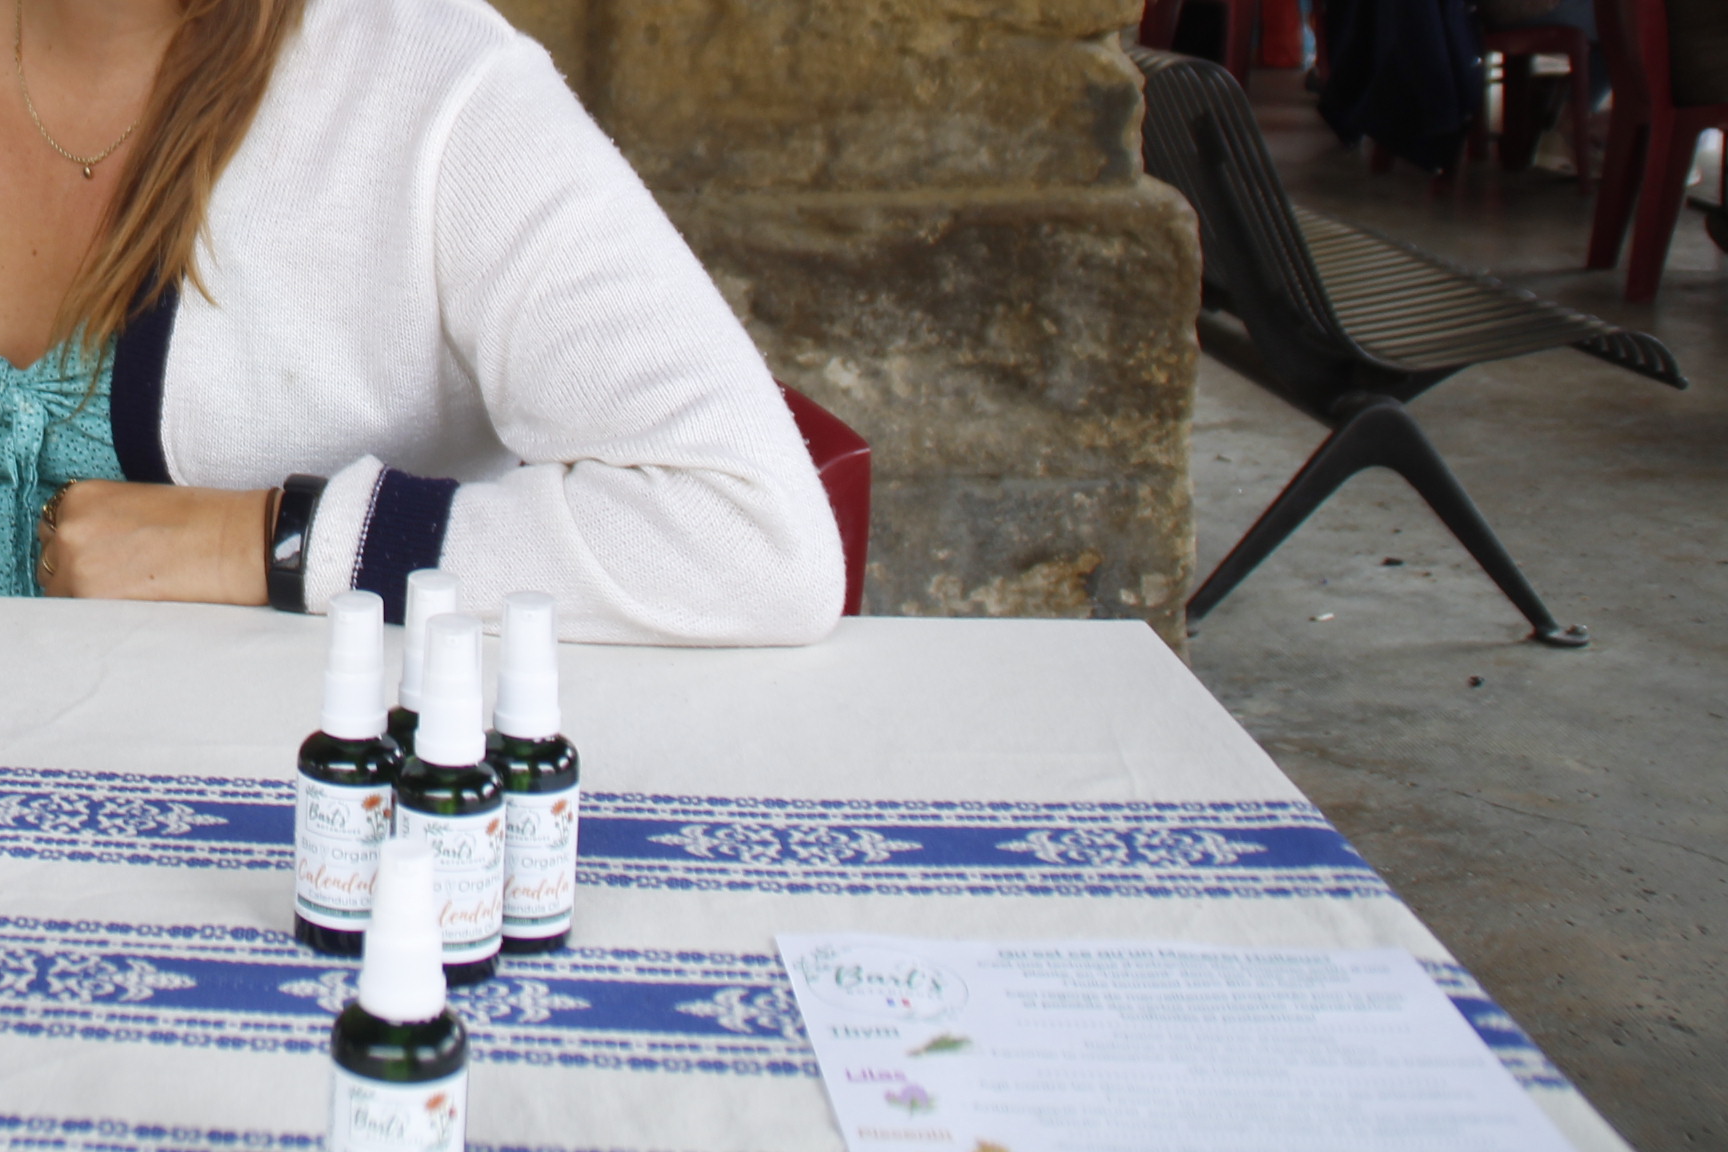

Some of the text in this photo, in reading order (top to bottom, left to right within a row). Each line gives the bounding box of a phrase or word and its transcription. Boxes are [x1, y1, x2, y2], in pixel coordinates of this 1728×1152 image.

[301, 836, 381, 865] Bio Organi
[298, 858, 380, 897] Calendul
